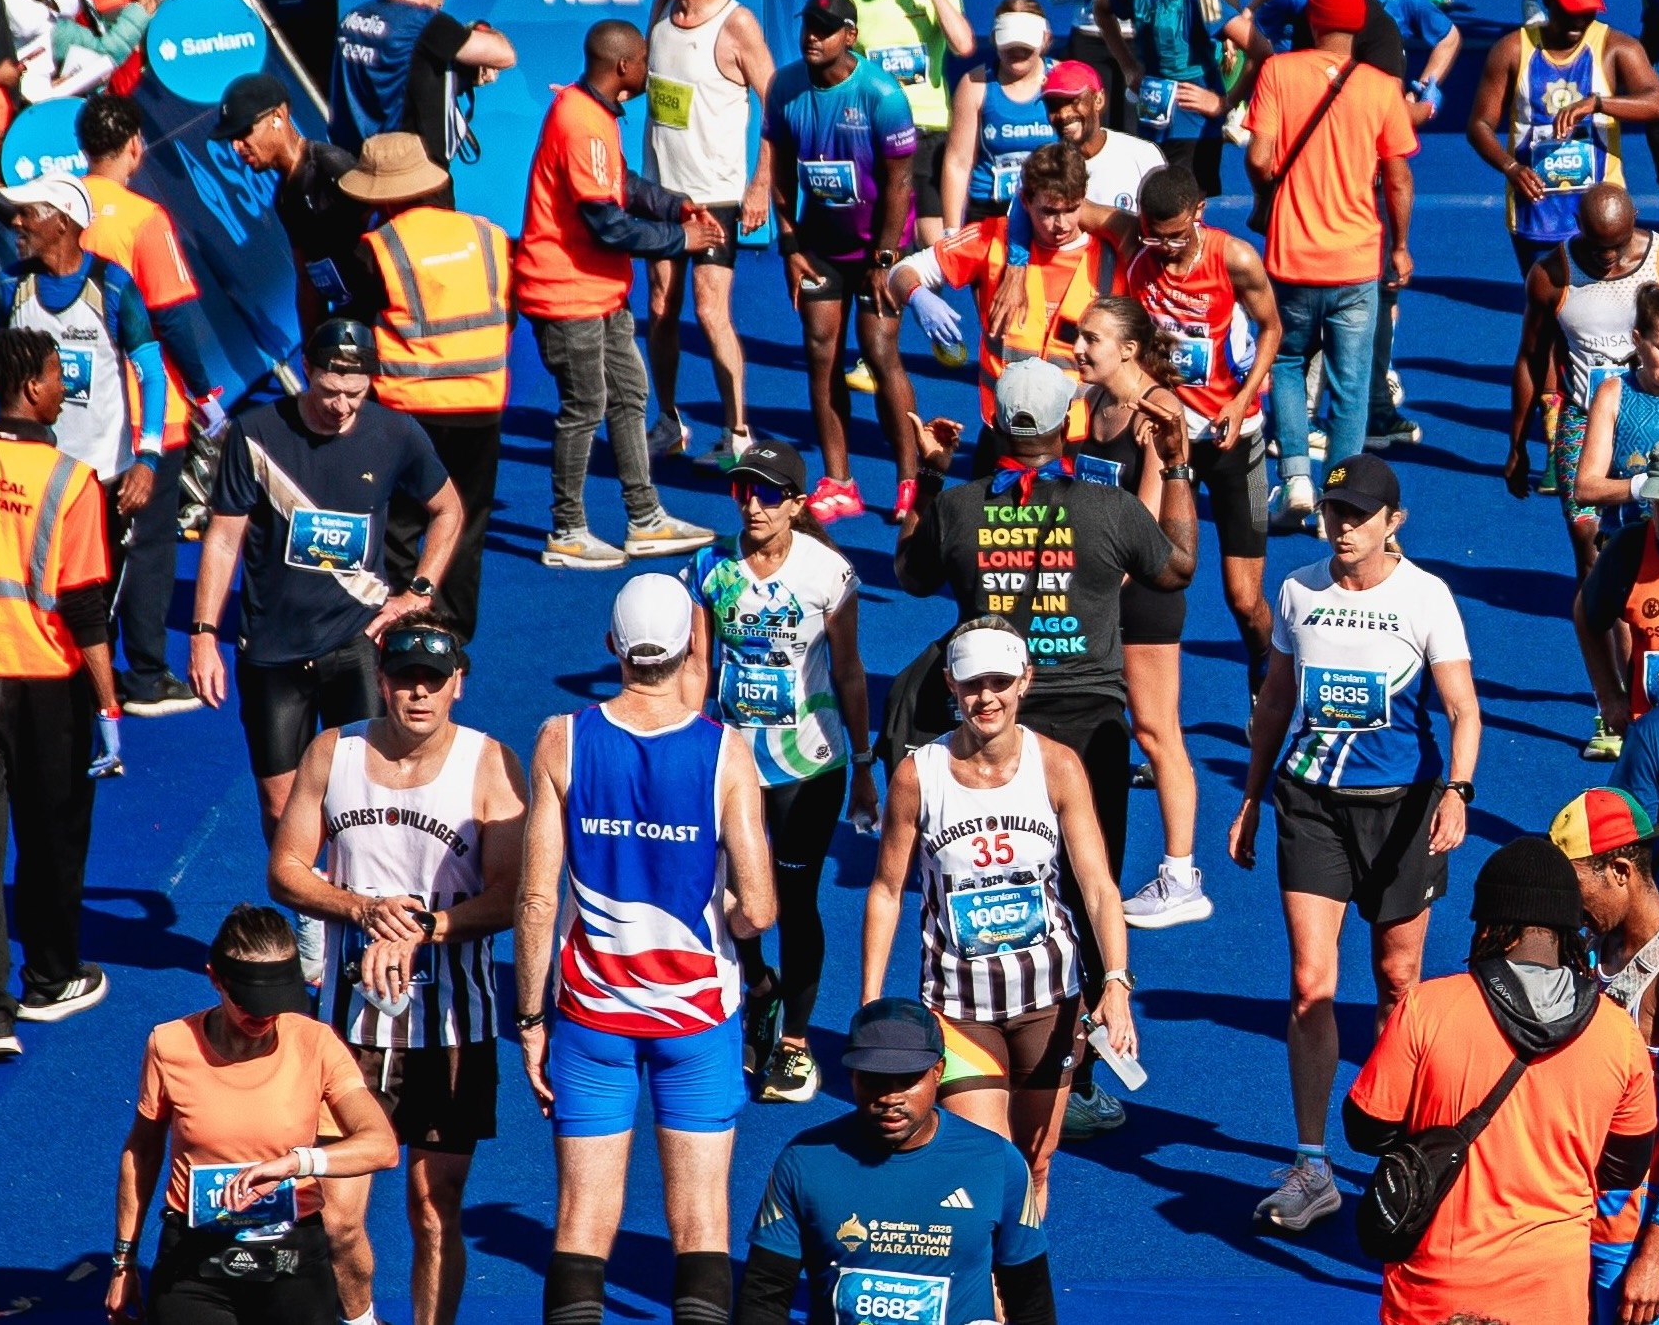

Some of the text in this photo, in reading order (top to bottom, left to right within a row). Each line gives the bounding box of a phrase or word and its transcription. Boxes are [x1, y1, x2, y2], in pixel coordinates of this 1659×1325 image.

[182, 32, 255, 56] Sanlam
[1001, 122, 1054, 139] Sanla
[1544, 155, 1582, 170] 8450
[1581, 334, 1629, 350] UNISA
[321, 516, 353, 529] Sanlam
[311, 528, 352, 548] 7197
[978, 550, 1075, 568] LONDON
[983, 573, 1073, 593] SYDEY
[989, 595, 1067, 613] BELIN
[721, 601, 800, 629] Jozi
[1311, 607, 1398, 622] HARFIELD
[723, 624, 797, 642] cross training
[1302, 615, 1400, 633] HARRIERS
[1027, 635, 1088, 654] YORK
[1331, 672, 1367, 684] Sanlam
[736, 683, 778, 700] 11571
[1319, 684, 1370, 704] 9835
[401, 809, 470, 858] VILLAGERS
[580, 818, 699, 842] WEST COAST
[999, 816, 1057, 848] VILLAGERS
[971, 832, 1014, 868] 35
[983, 891, 1021, 904] Sanlam
[966, 901, 1030, 928] 10057
[880, 1219, 952, 1233] Sanlam 2026
[870, 1231, 953, 1246] CAPE TOWN
[870, 1243, 950, 1257] MARATHON
[874, 1279, 919, 1295] Sanlam
[855, 1295, 920, 1321] 8682
